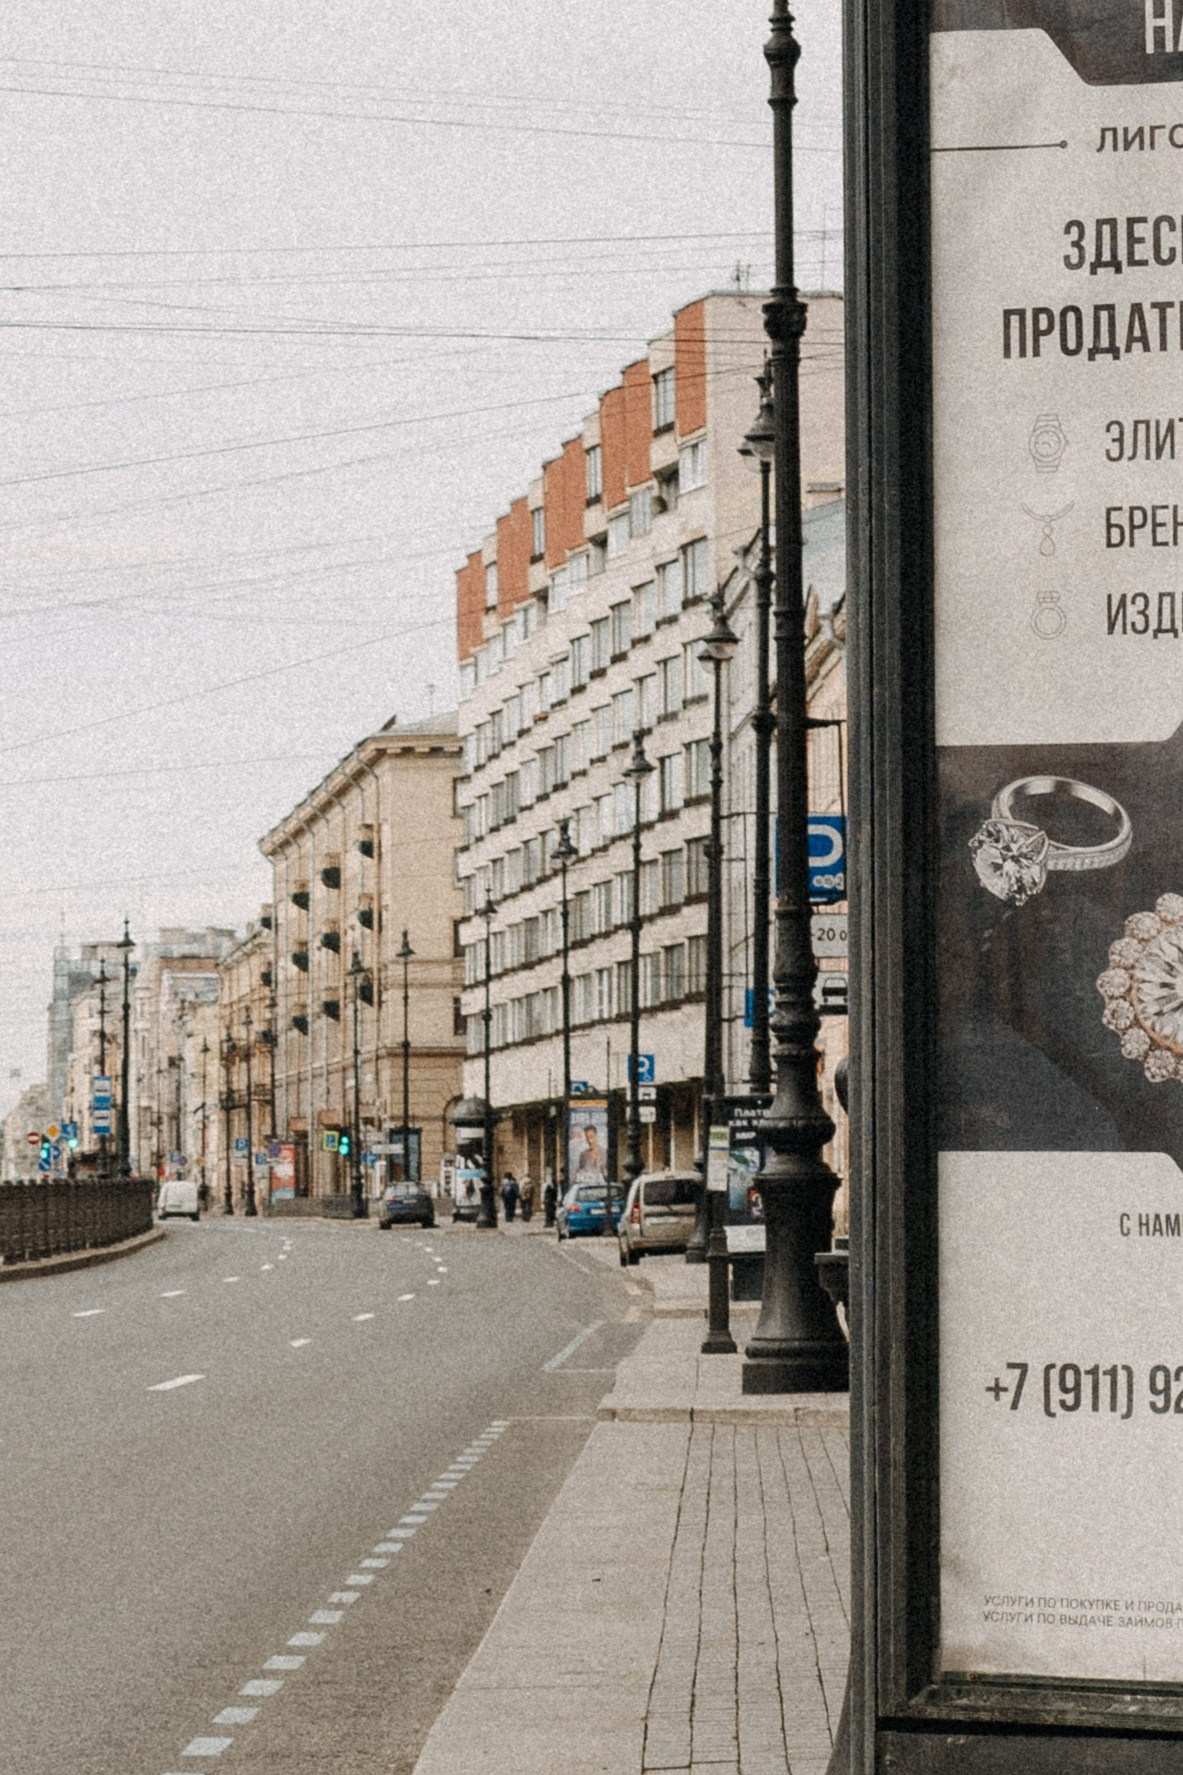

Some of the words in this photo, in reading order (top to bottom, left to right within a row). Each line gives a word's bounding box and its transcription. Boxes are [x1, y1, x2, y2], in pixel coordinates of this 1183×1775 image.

[1145, 0, 1183, 54] Н
[1063, 214, 1183, 275] ЗДЕС
[1003, 301, 1183, 361] ПРОДАТ
[1105, 418, 1183, 462] ЭЛИ
[1107, 592, 1183, 639] ИЗД
[1119, 1213, 1131, 1236] С
[1138, 1213, 1183, 1237] НАМ
[985, 1362, 1029, 1411] +7
[1043, 1363, 1134, 1420] (911)
[982, 1611, 1034, 1624] УСЛУГИ
[1037, 1612, 1056, 1625] ПО
[1059, 1614, 1114, 1628] ВЫДАЧЕ
[1118, 1615, 1173, 1629] ЗАЙМОВ
[984, 1595, 1034, 1608] УСЛУГИ
[1038, 1597, 1057, 1609] ПО
[1060, 1598, 1121, 1611] ПОКУПКЕ
[1125, 1600, 1134, 1611] И
